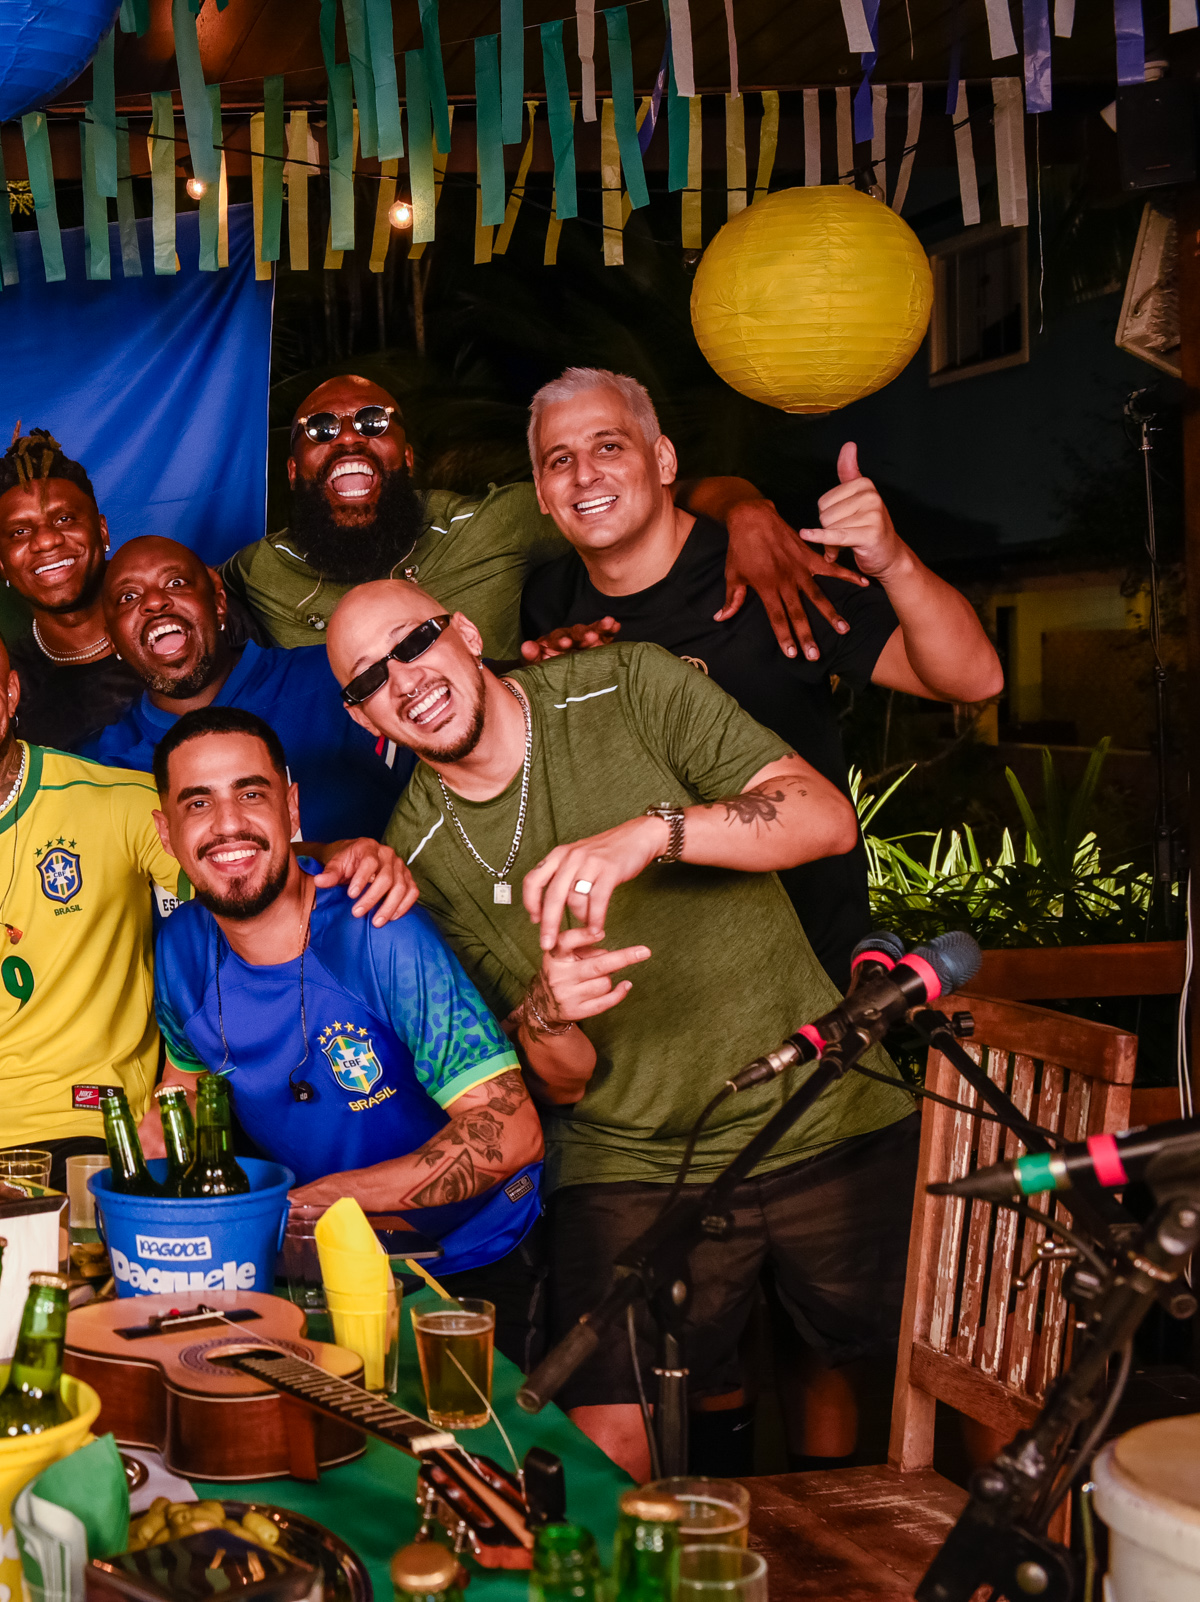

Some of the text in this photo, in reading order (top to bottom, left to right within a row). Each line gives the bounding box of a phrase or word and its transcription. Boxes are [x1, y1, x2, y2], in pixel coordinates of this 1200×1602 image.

[53, 904, 83, 916] BRASIL
[1, 955, 35, 1016] 9
[342, 1057, 362, 1068] CBF
[106, 1088, 114, 1097] S
[348, 1086, 397, 1112] BRASIL
[140, 1240, 207, 1257] PAGODE
[110, 1246, 257, 1295] Daquele
